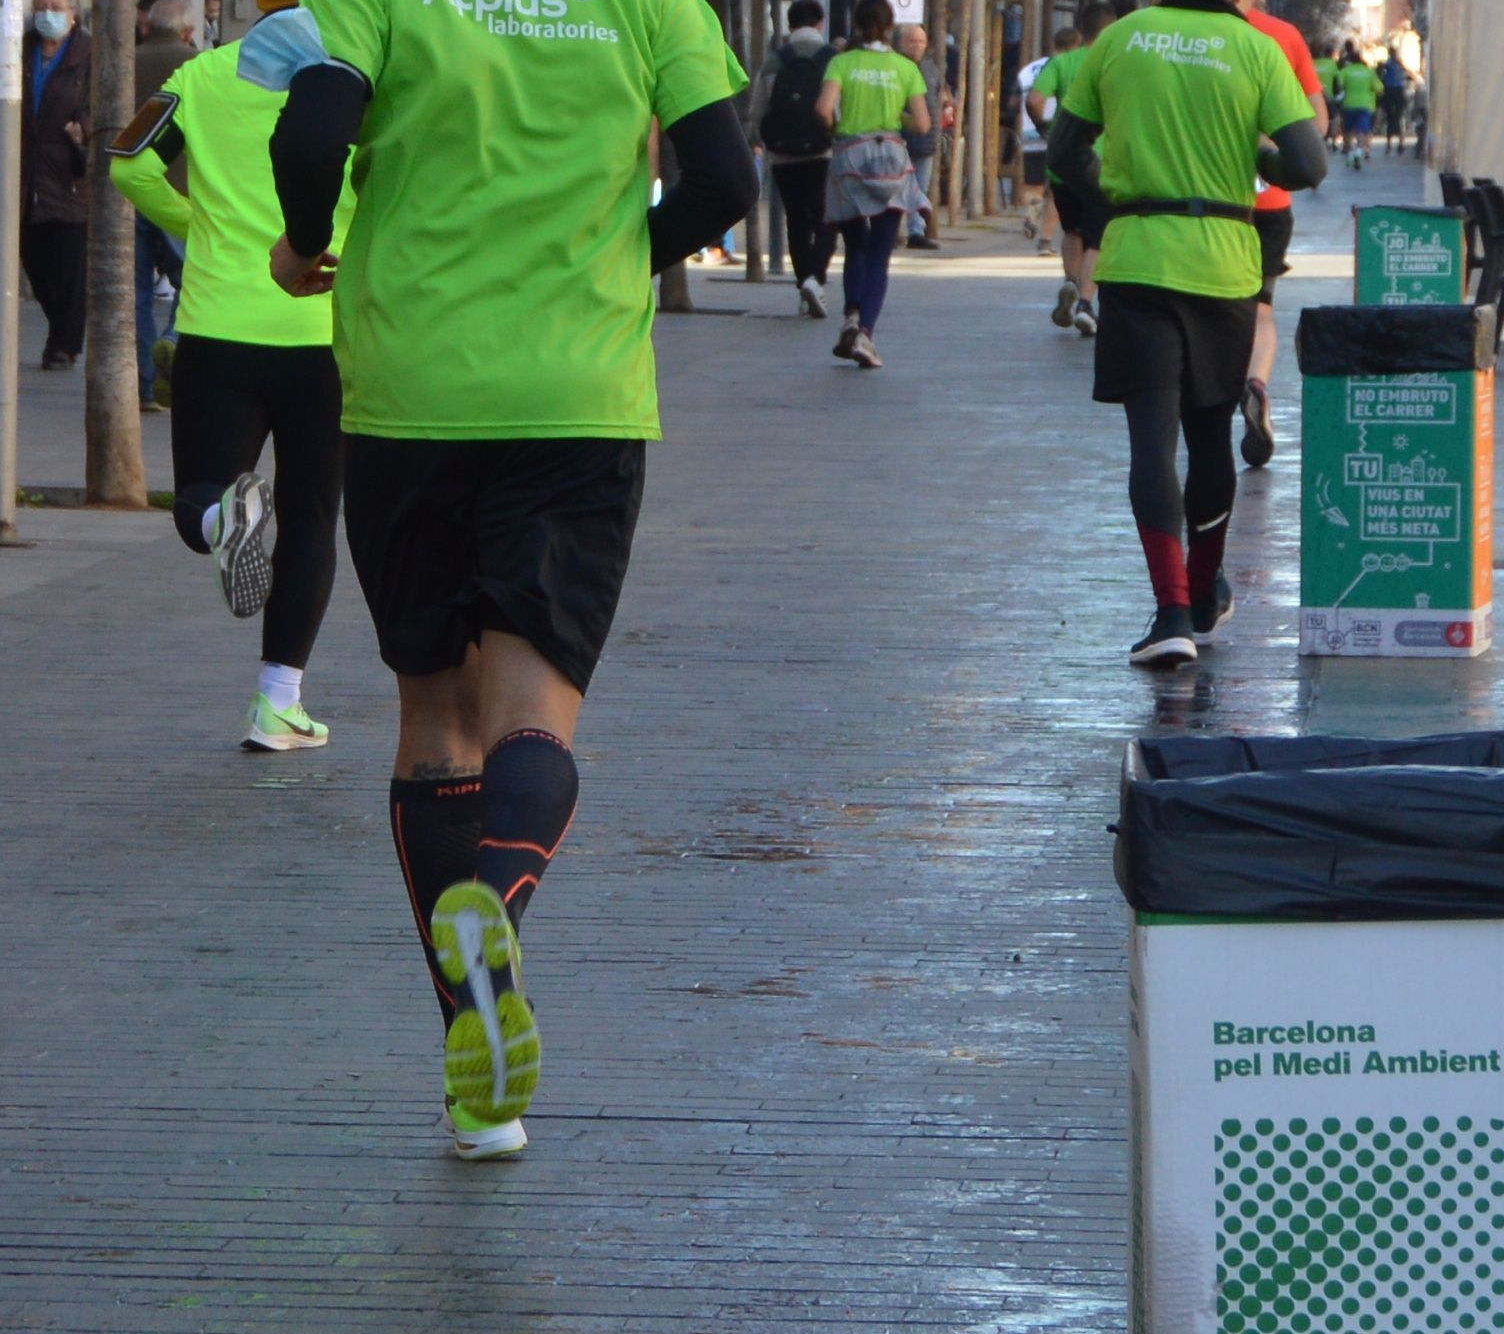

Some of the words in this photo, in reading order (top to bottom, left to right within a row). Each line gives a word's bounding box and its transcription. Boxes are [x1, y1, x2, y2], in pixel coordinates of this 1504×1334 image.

[487, 13, 620, 44] laboratories
[1354, 389, 1376, 402] NO
[1378, 389, 1450, 403] EMBRUTO
[1354, 404, 1373, 417] EL
[1375, 404, 1435, 418] CARRER
[1350, 460, 1378, 479] TU
[1366, 488, 1402, 502] VIUS
[1404, 488, 1425, 502] EN
[1366, 505, 1398, 518] UNA
[1401, 505, 1453, 518] CIUTAT
[1366, 517, 1398, 536] MÉS
[1401, 522, 1440, 536] NETA
[1213, 1020, 1376, 1045] Barcelona
[1214, 1052, 1262, 1083] pel
[1272, 1051, 1352, 1076] Medi
[1362, 1049, 1502, 1075] Ambient
